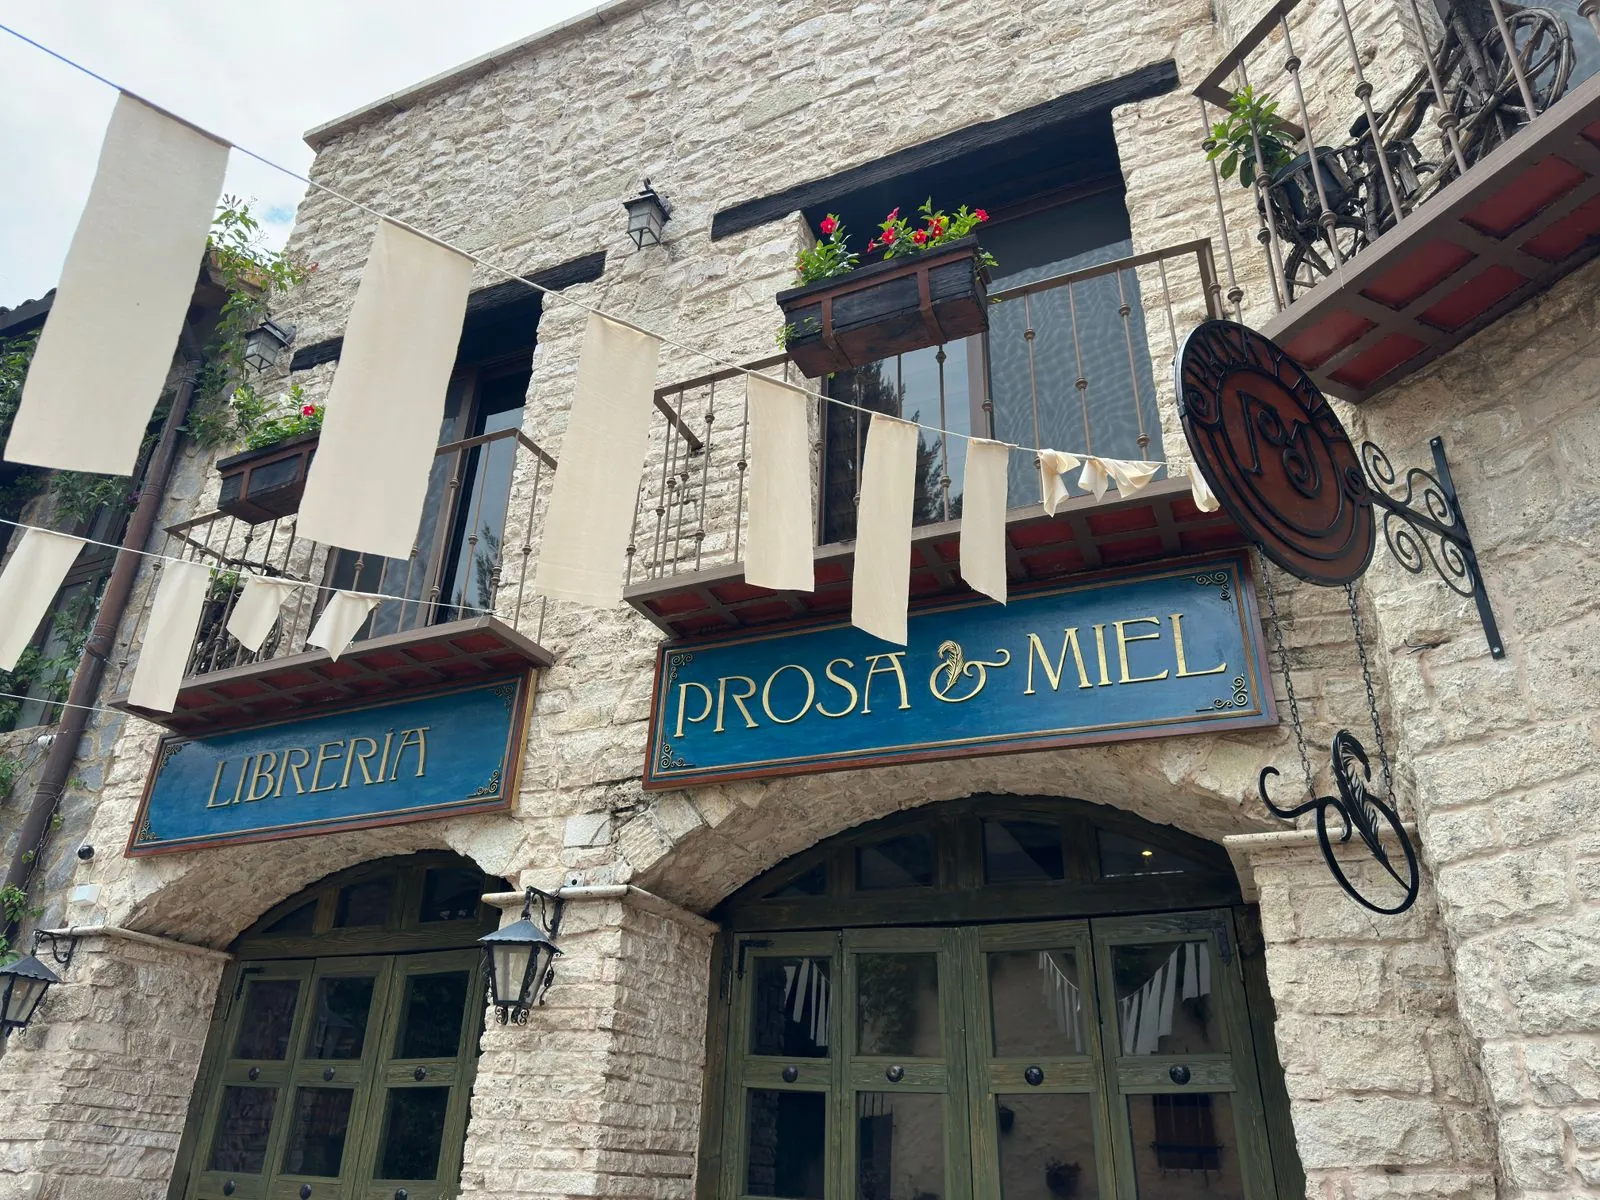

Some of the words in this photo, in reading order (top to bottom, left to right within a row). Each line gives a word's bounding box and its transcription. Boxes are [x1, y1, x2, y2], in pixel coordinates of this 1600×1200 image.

[673, 651, 912, 738] PROSA
[929, 640, 1012, 702] &
[1023, 612, 1228, 696] MIEL
[205, 726, 431, 809] LIBRERÍA
